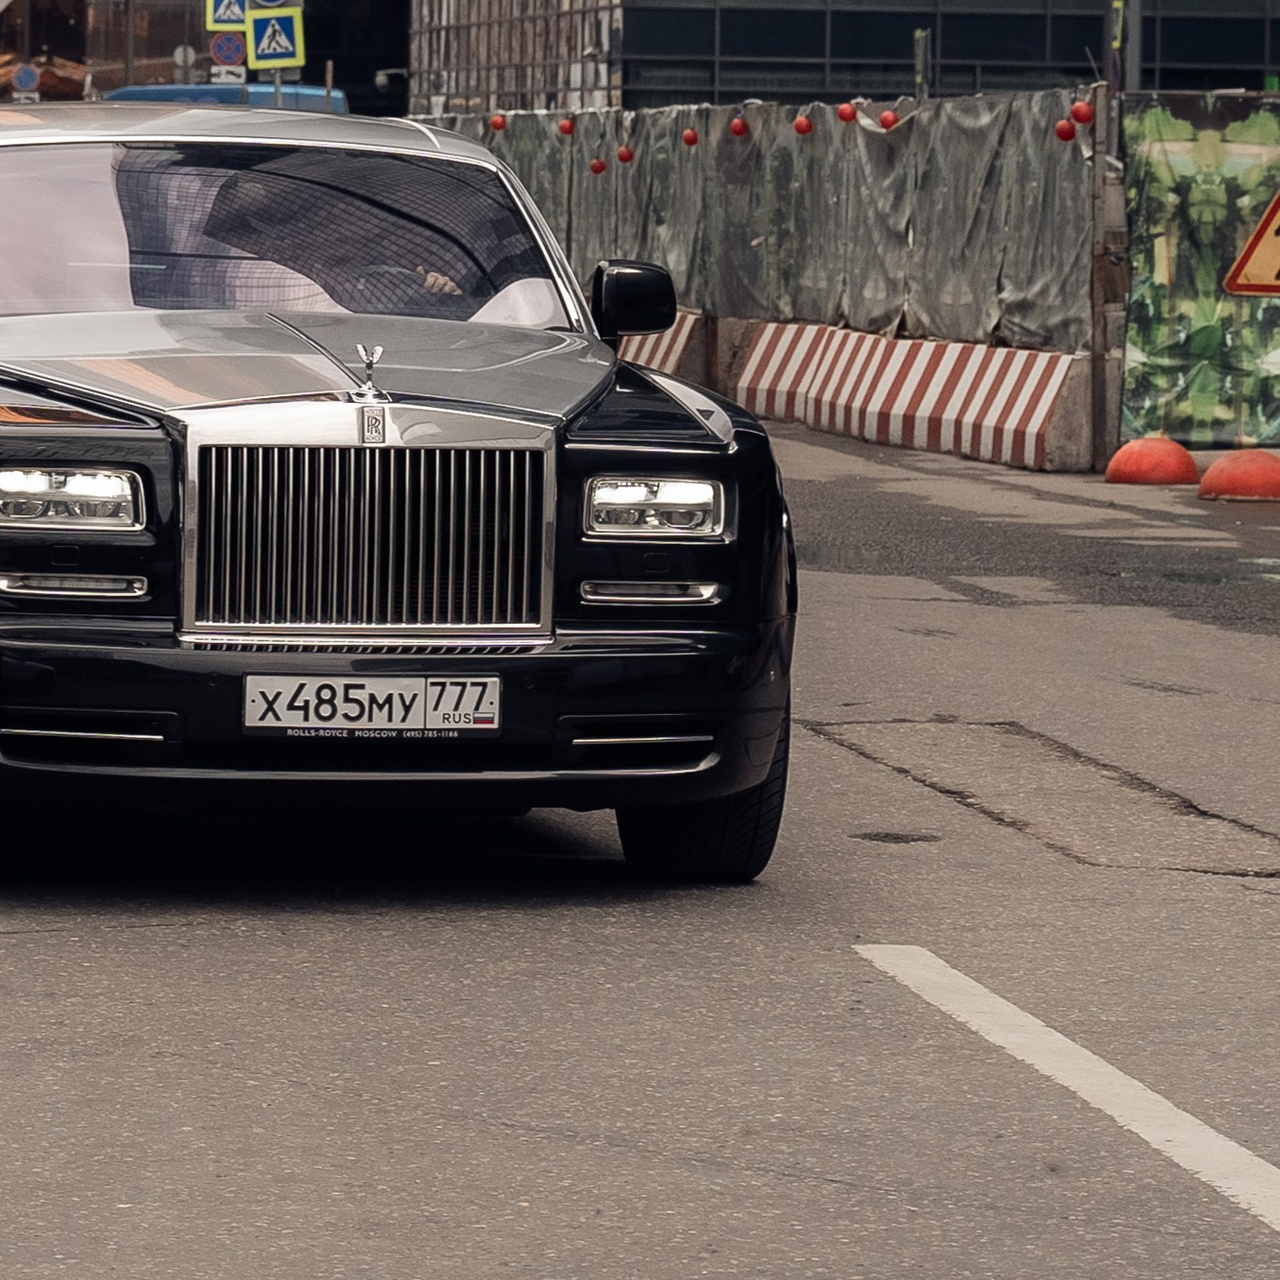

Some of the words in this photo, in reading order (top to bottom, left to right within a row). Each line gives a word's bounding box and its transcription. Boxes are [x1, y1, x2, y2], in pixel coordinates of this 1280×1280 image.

[429, 681, 488, 712] 777
[442, 713, 472, 724] RUS
[287, 728, 348, 737] ROLLS-ROYCE
[355, 729, 397, 738] MOSCOW
